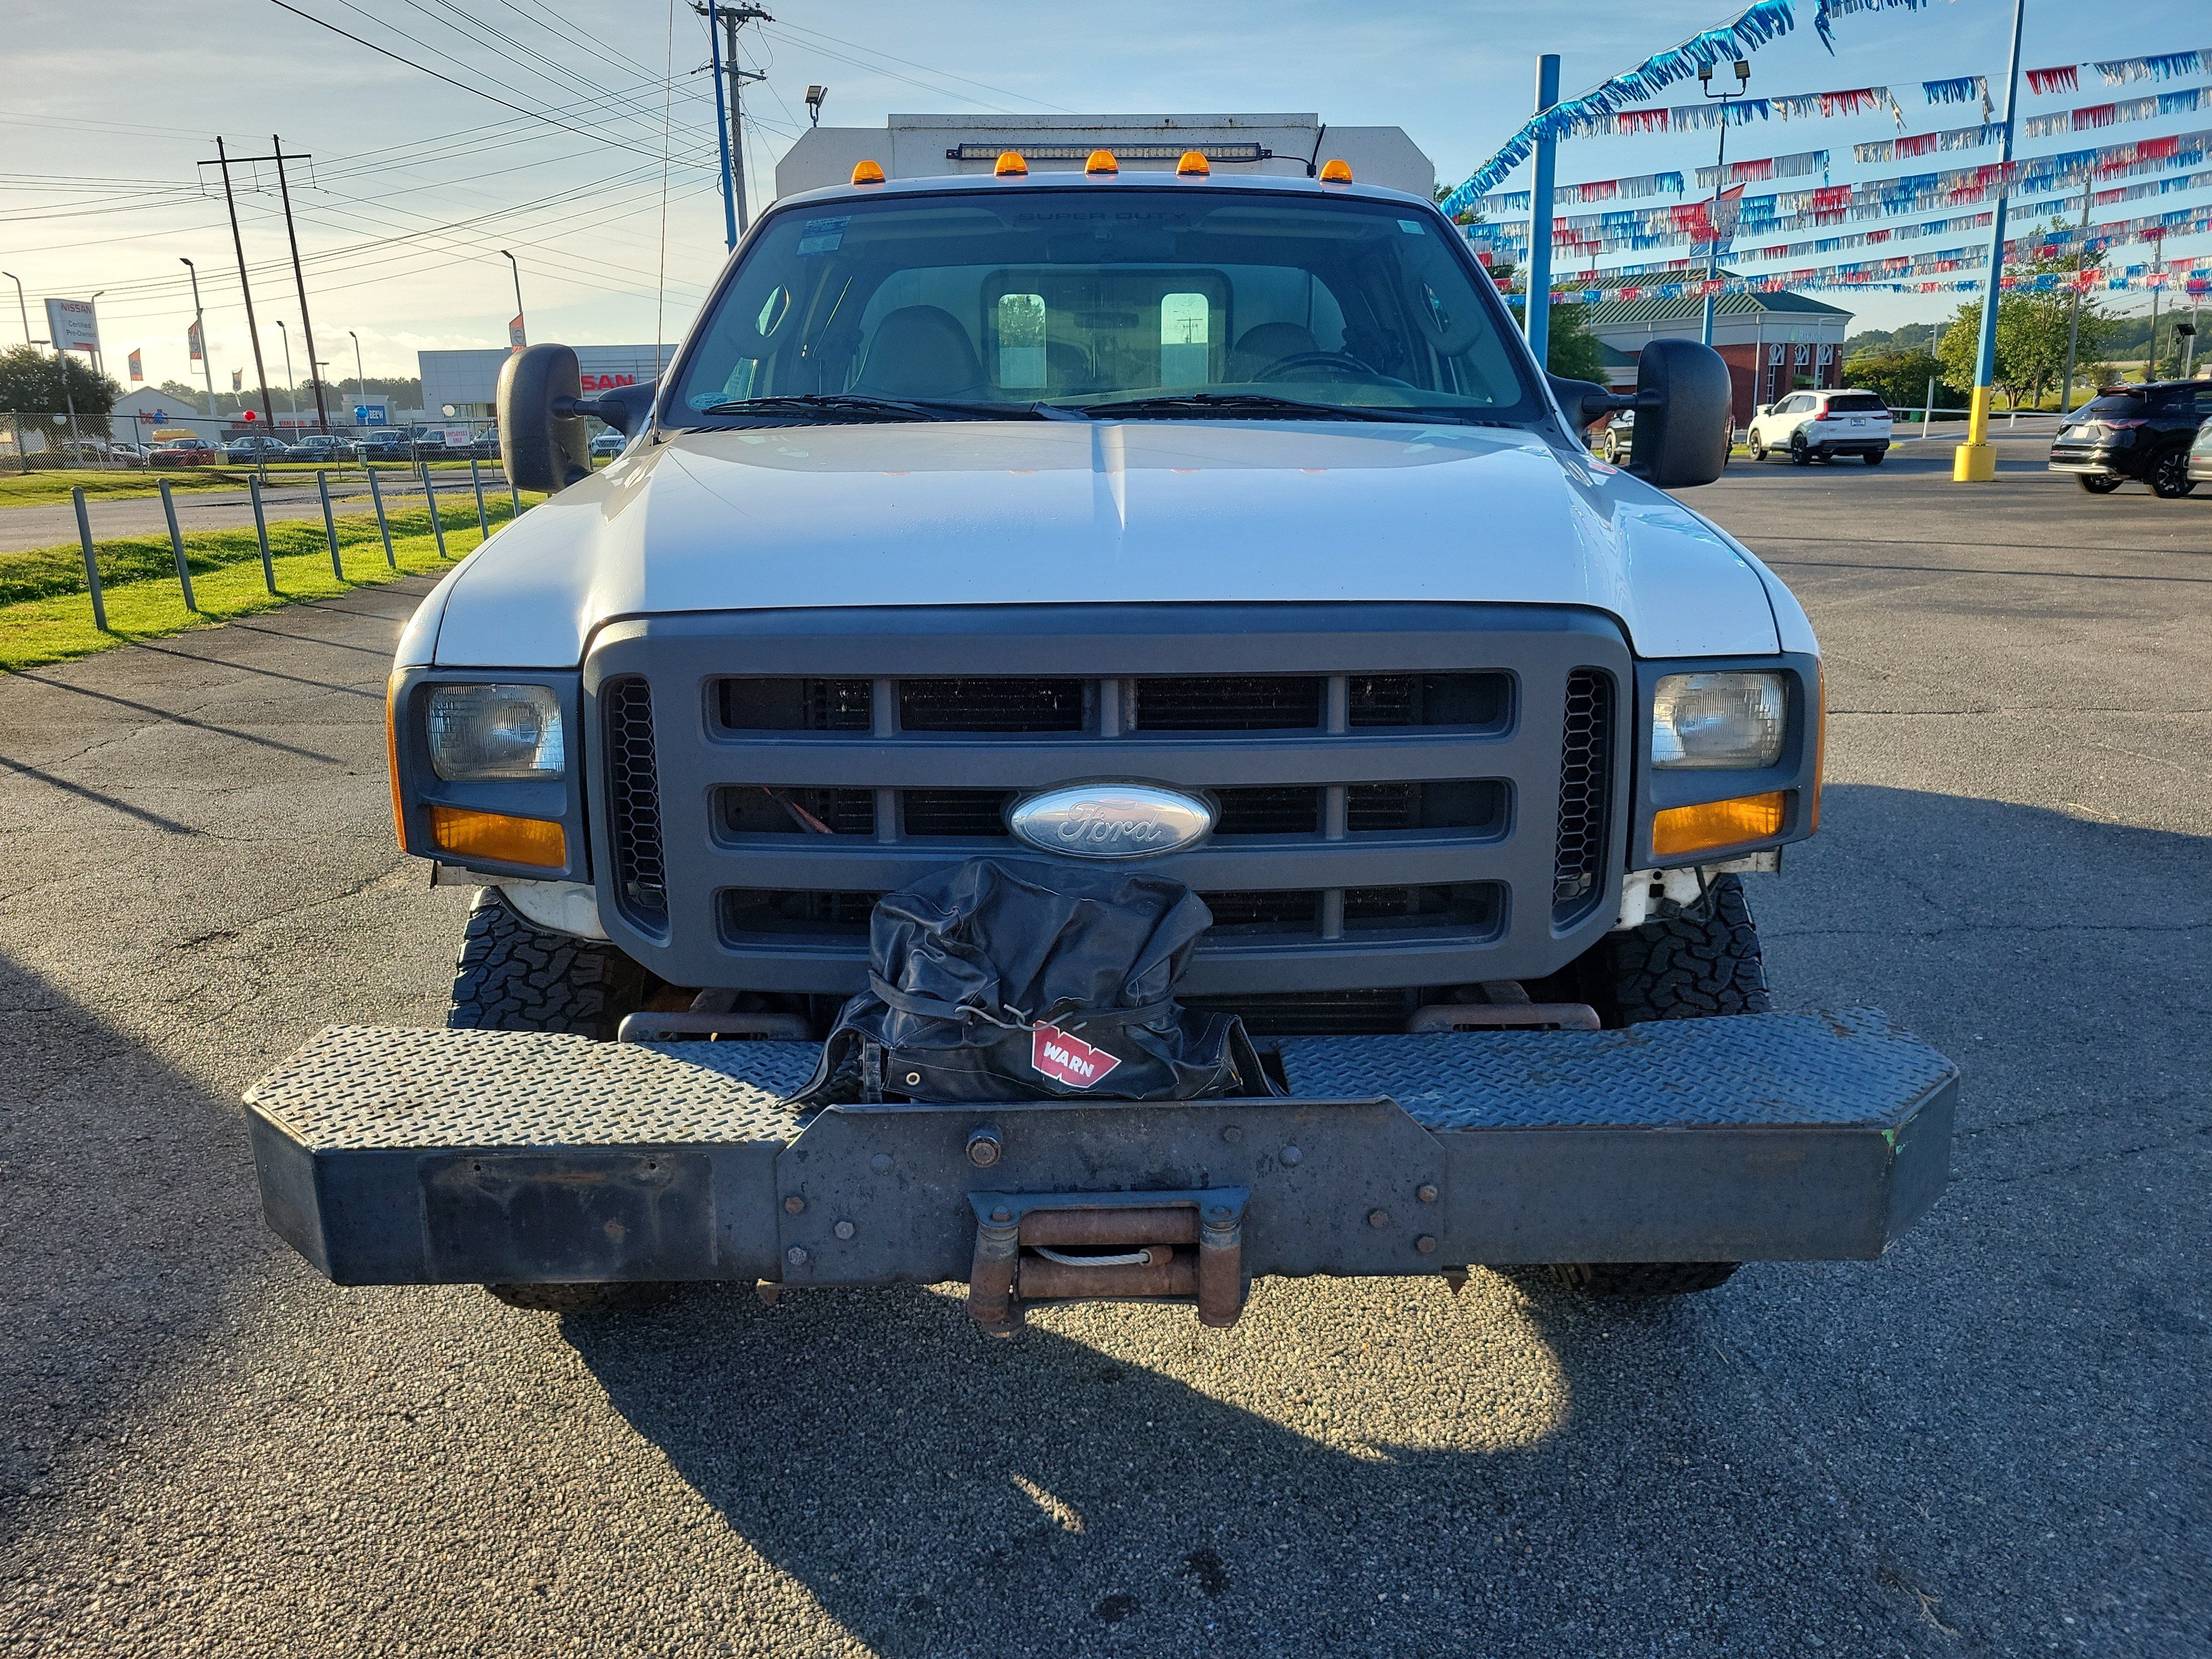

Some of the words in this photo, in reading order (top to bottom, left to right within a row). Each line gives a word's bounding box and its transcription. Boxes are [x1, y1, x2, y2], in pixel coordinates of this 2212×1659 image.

[60, 302, 92, 314] NISSAN
[68, 320, 92, 329] Certified
[66, 329, 97, 338] Pre-Owned
[1057, 800, 1161, 842] Ford
[1043, 1041, 1094, 1077] WARN
